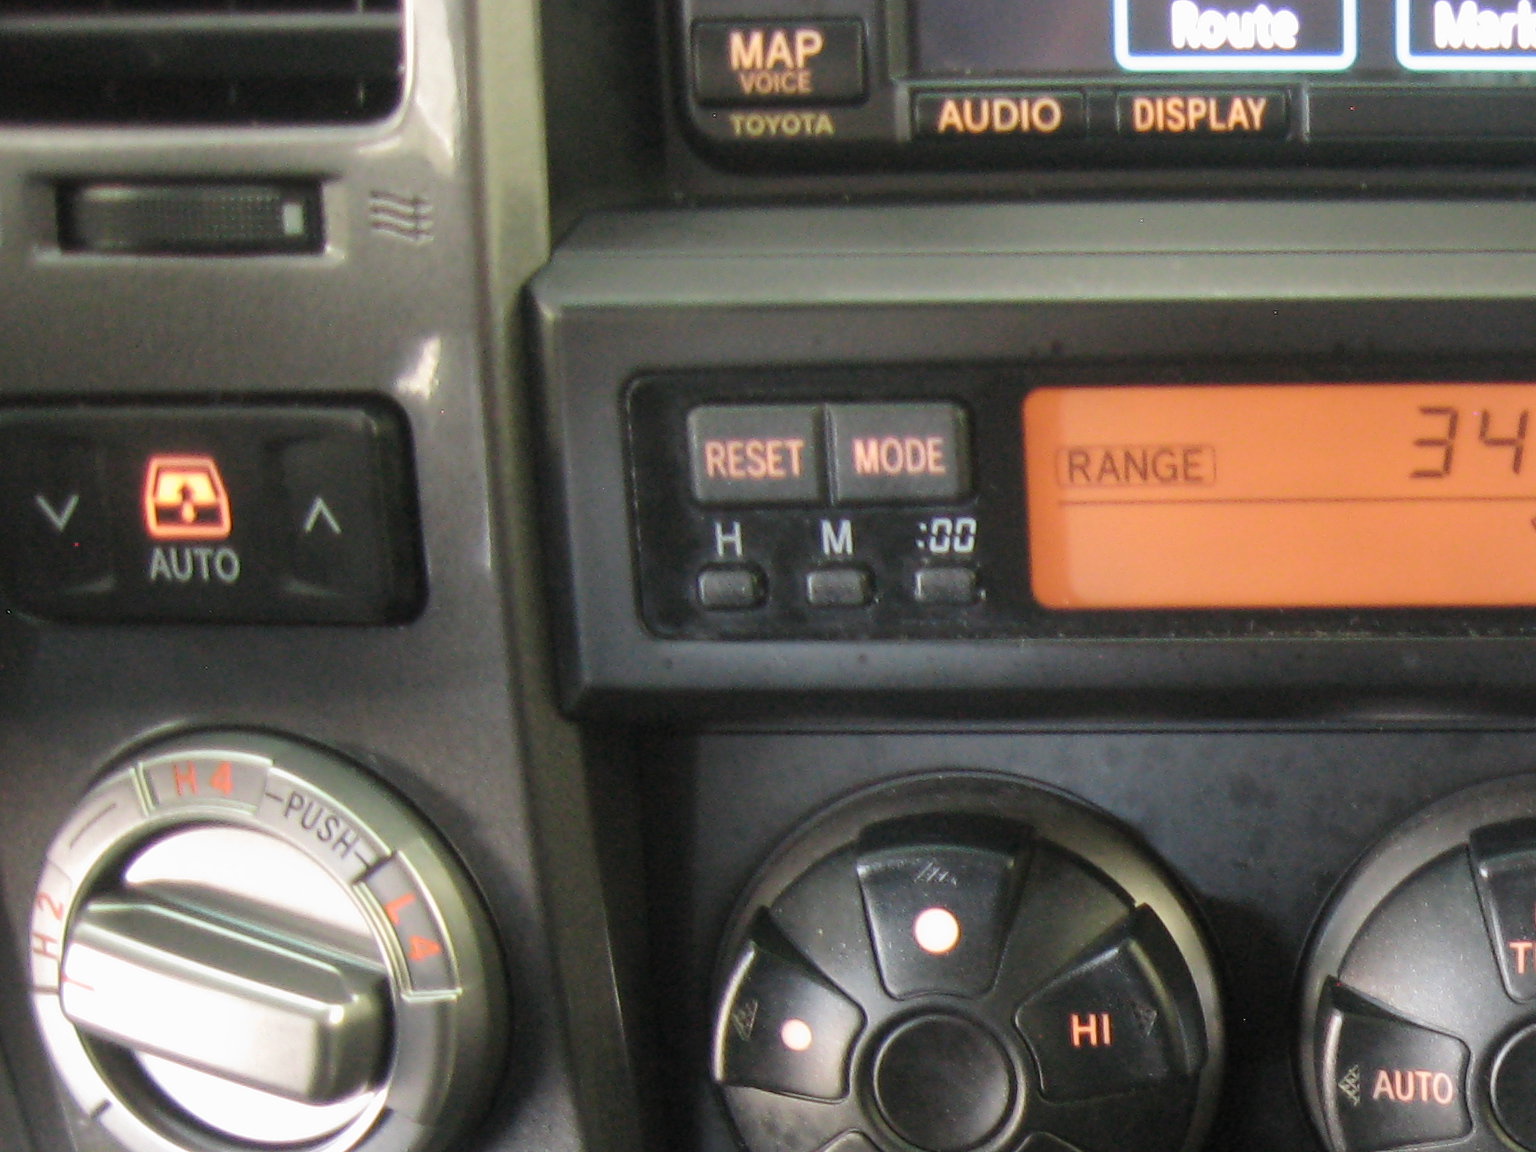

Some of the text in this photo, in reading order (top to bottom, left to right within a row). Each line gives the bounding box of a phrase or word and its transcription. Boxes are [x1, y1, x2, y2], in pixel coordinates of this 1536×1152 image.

[1170, 0, 1300, 49] Route
[729, 28, 824, 71] MAP
[738, 72, 813, 95] VOICE
[730, 112, 835, 137] TOYOTA
[937, 98, 1062, 133] AUDIO
[1133, 97, 1267, 132] DISPLAY
[705, 438, 805, 479] RESET
[853, 436, 947, 475] MODE
[1409, 405, 1530, 480] 34
[1067, 447, 1203, 484] RANGE
[714, 522, 743, 557] H
[821, 520, 854, 555] M
[150, 546, 240, 583] AUTO
[1070, 1012, 1113, 1048] HI
[1372, 1069, 1454, 1105] AUTO
